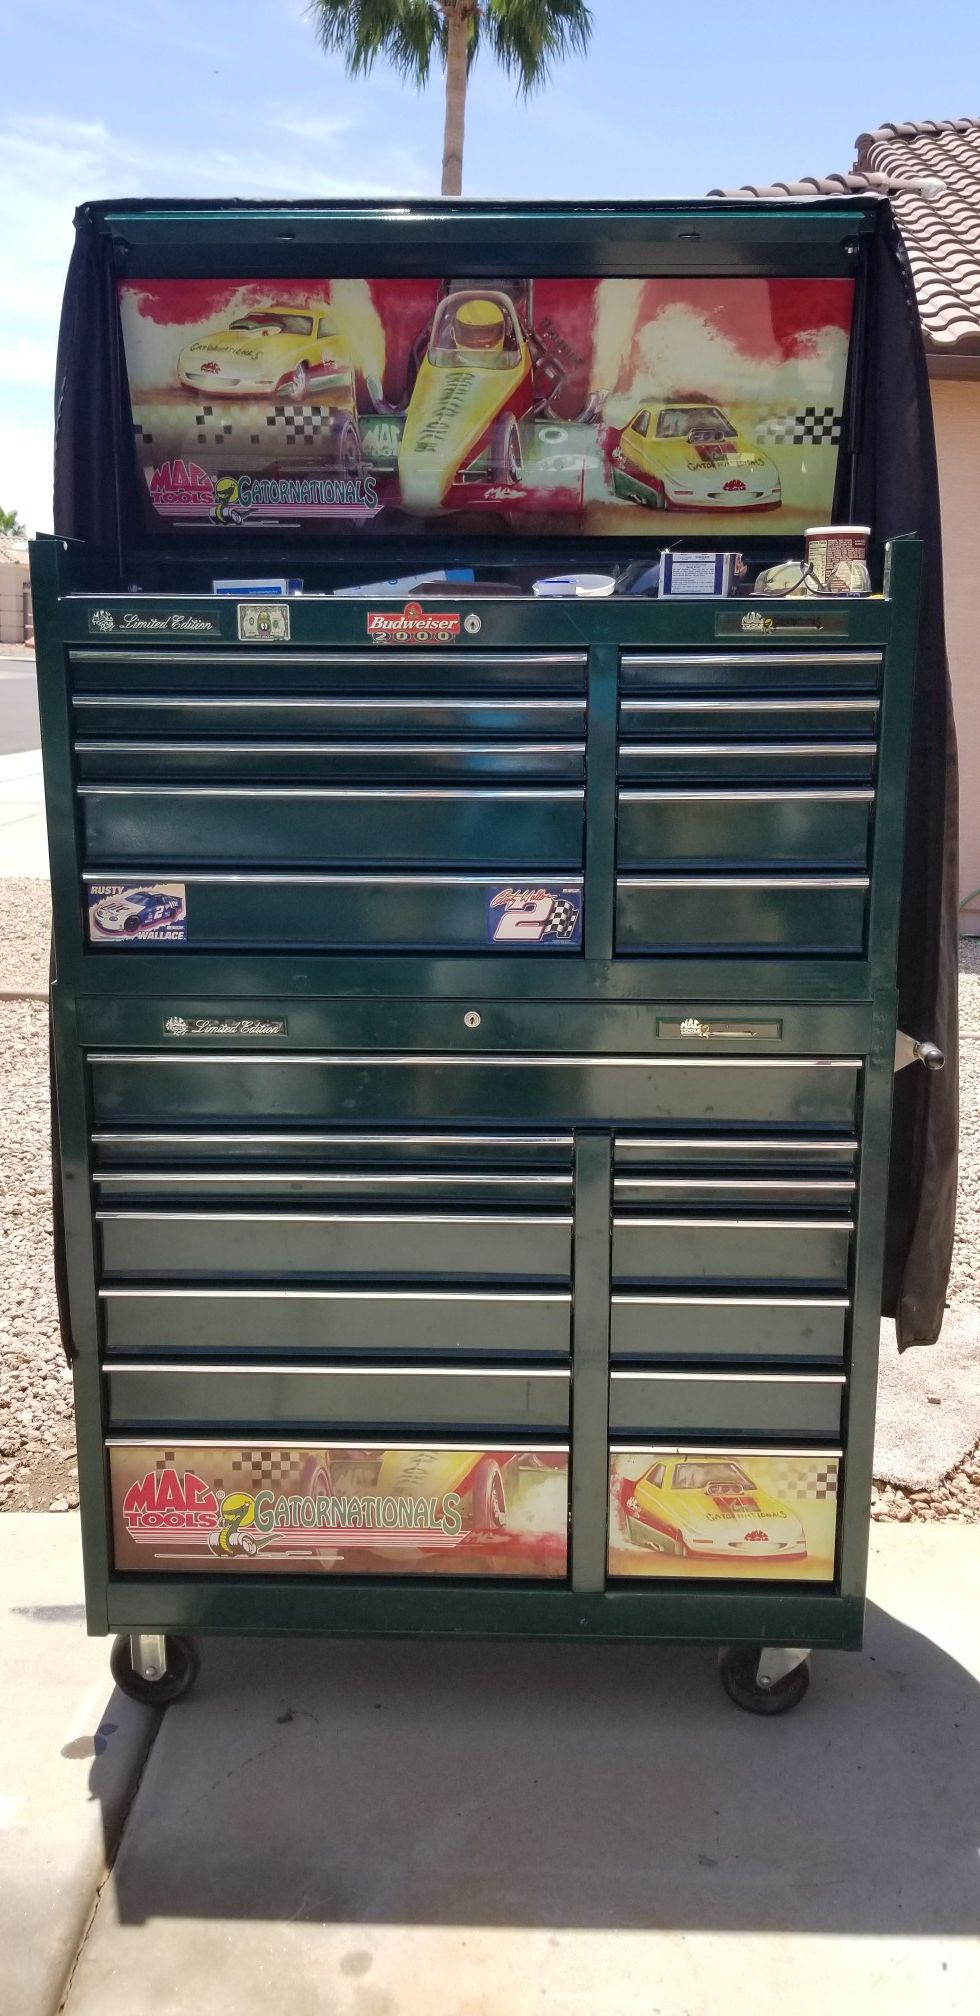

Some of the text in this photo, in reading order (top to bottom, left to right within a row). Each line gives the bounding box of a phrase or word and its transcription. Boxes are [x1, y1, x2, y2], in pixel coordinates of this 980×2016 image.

[150, 459, 214, 493] MAC
[150, 475, 378, 509] TOOLS GATORNATIONALS
[120, 614, 171, 629] Limited
[171, 615, 213, 630] Edition
[370, 616, 458, 629] Budweiser
[91, 886, 124, 895] RUSTY
[153, 905, 164, 920] 2
[494, 898, 554, 941] 2
[137, 931, 185, 940] WALLACE
[192, 1020, 241, 1034] Limited
[241, 1020, 281, 1034] Edition
[123, 1469, 219, 1513] MAC
[123, 1490, 463, 1536] TOOLS GATORNATIONALS
